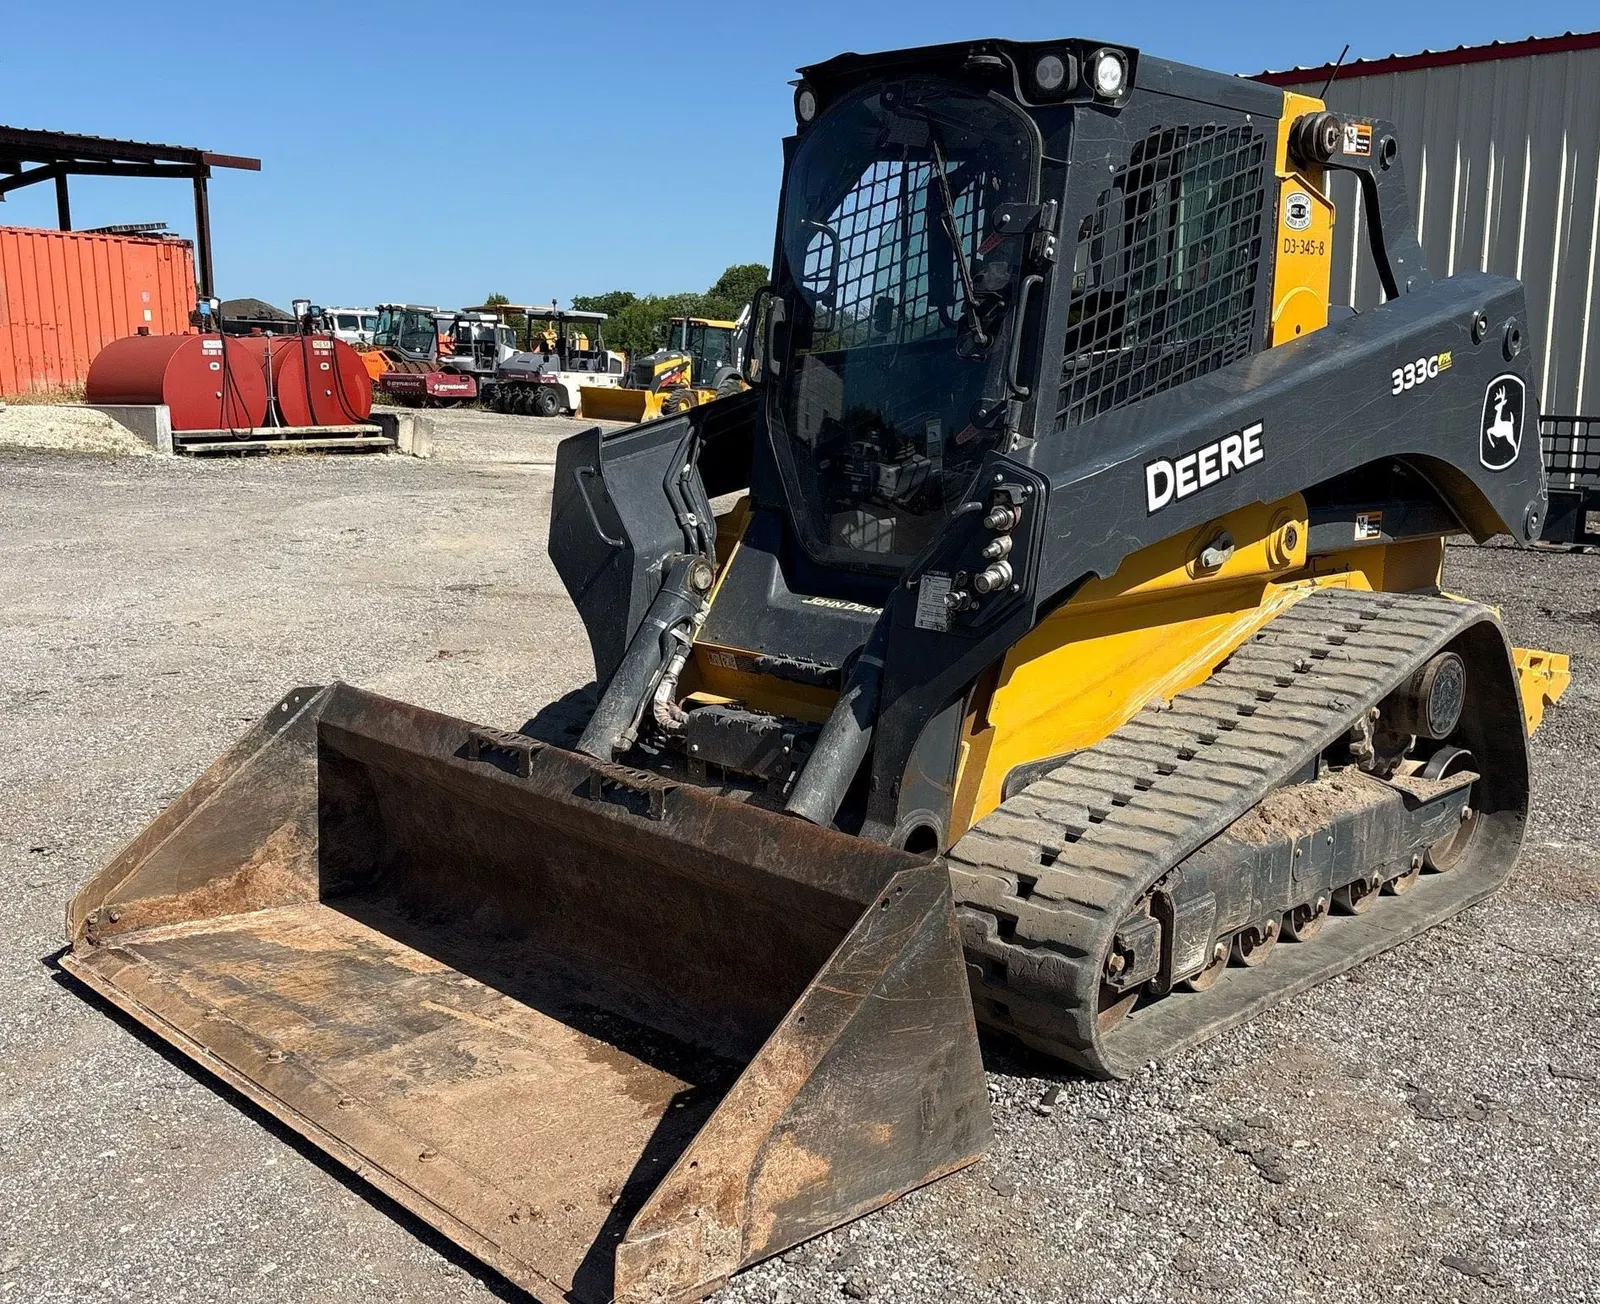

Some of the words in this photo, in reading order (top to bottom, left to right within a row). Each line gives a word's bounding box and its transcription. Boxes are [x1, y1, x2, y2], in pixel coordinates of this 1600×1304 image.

[1283, 238, 1325, 256] D3-345-8
[1392, 355, 1438, 395] 333G
[1146, 423, 1264, 512] DEERE
[802, 597, 845, 608] JOHN
[844, 602, 884, 615] DEER
